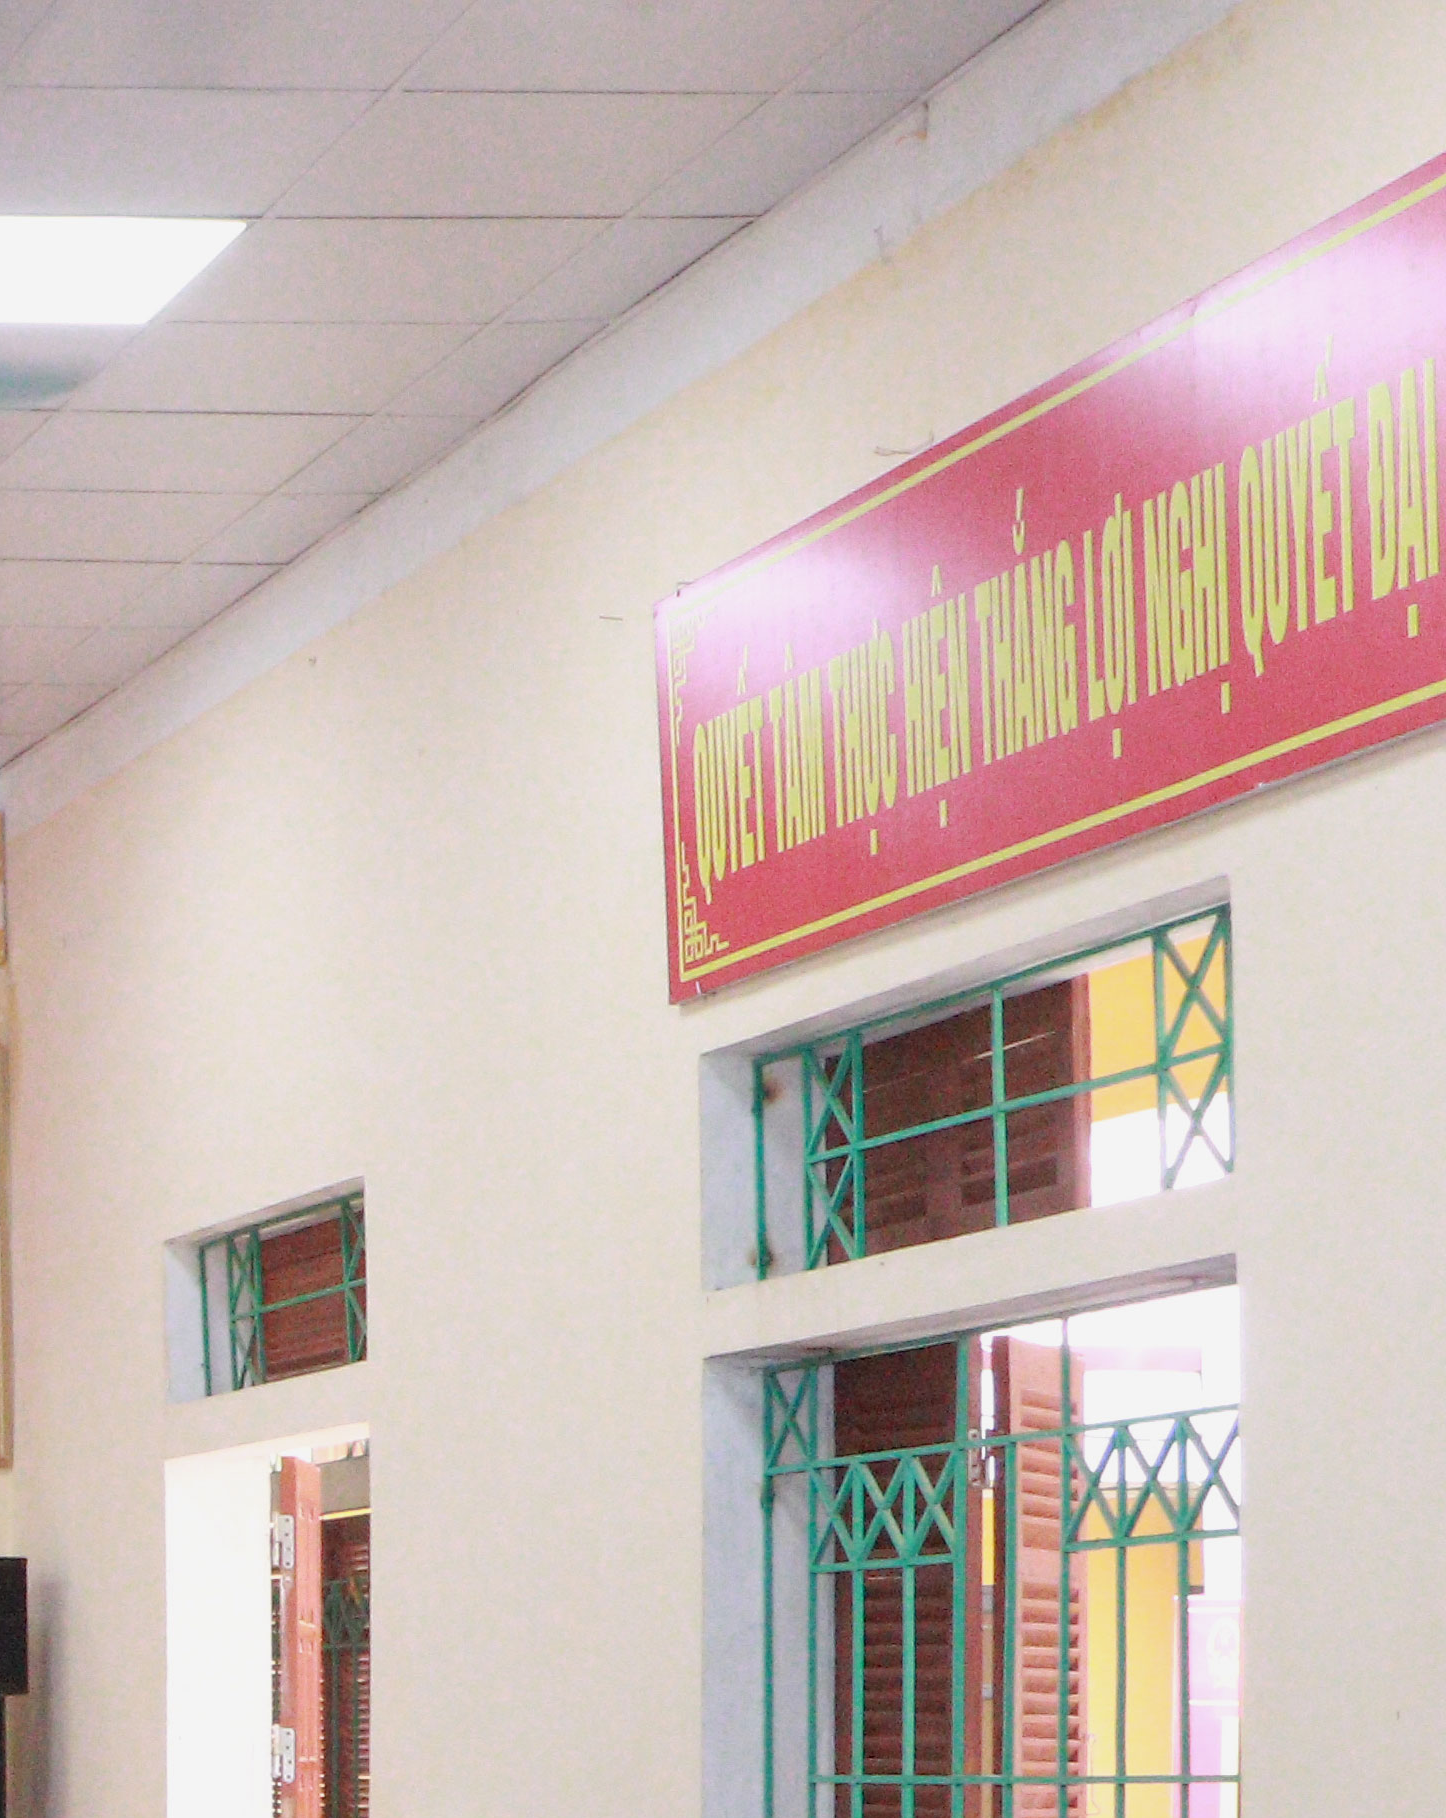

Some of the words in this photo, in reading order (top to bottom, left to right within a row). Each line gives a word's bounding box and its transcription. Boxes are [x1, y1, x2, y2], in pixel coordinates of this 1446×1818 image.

[692, 644, 765, 904] QUYẾT
[768, 642, 826, 853] TÂM
[829, 620, 897, 854] THỰC
[902, 564, 971, 827] HIỆN
[976, 488, 1078, 765] THẮNG
[1082, 492, 1136, 759] LỢI
[1143, 462, 1231, 714] NGHỊ
[1238, 333, 1355, 676] QUYẾT
[1367, 357, 1439, 638] ĐẠI
